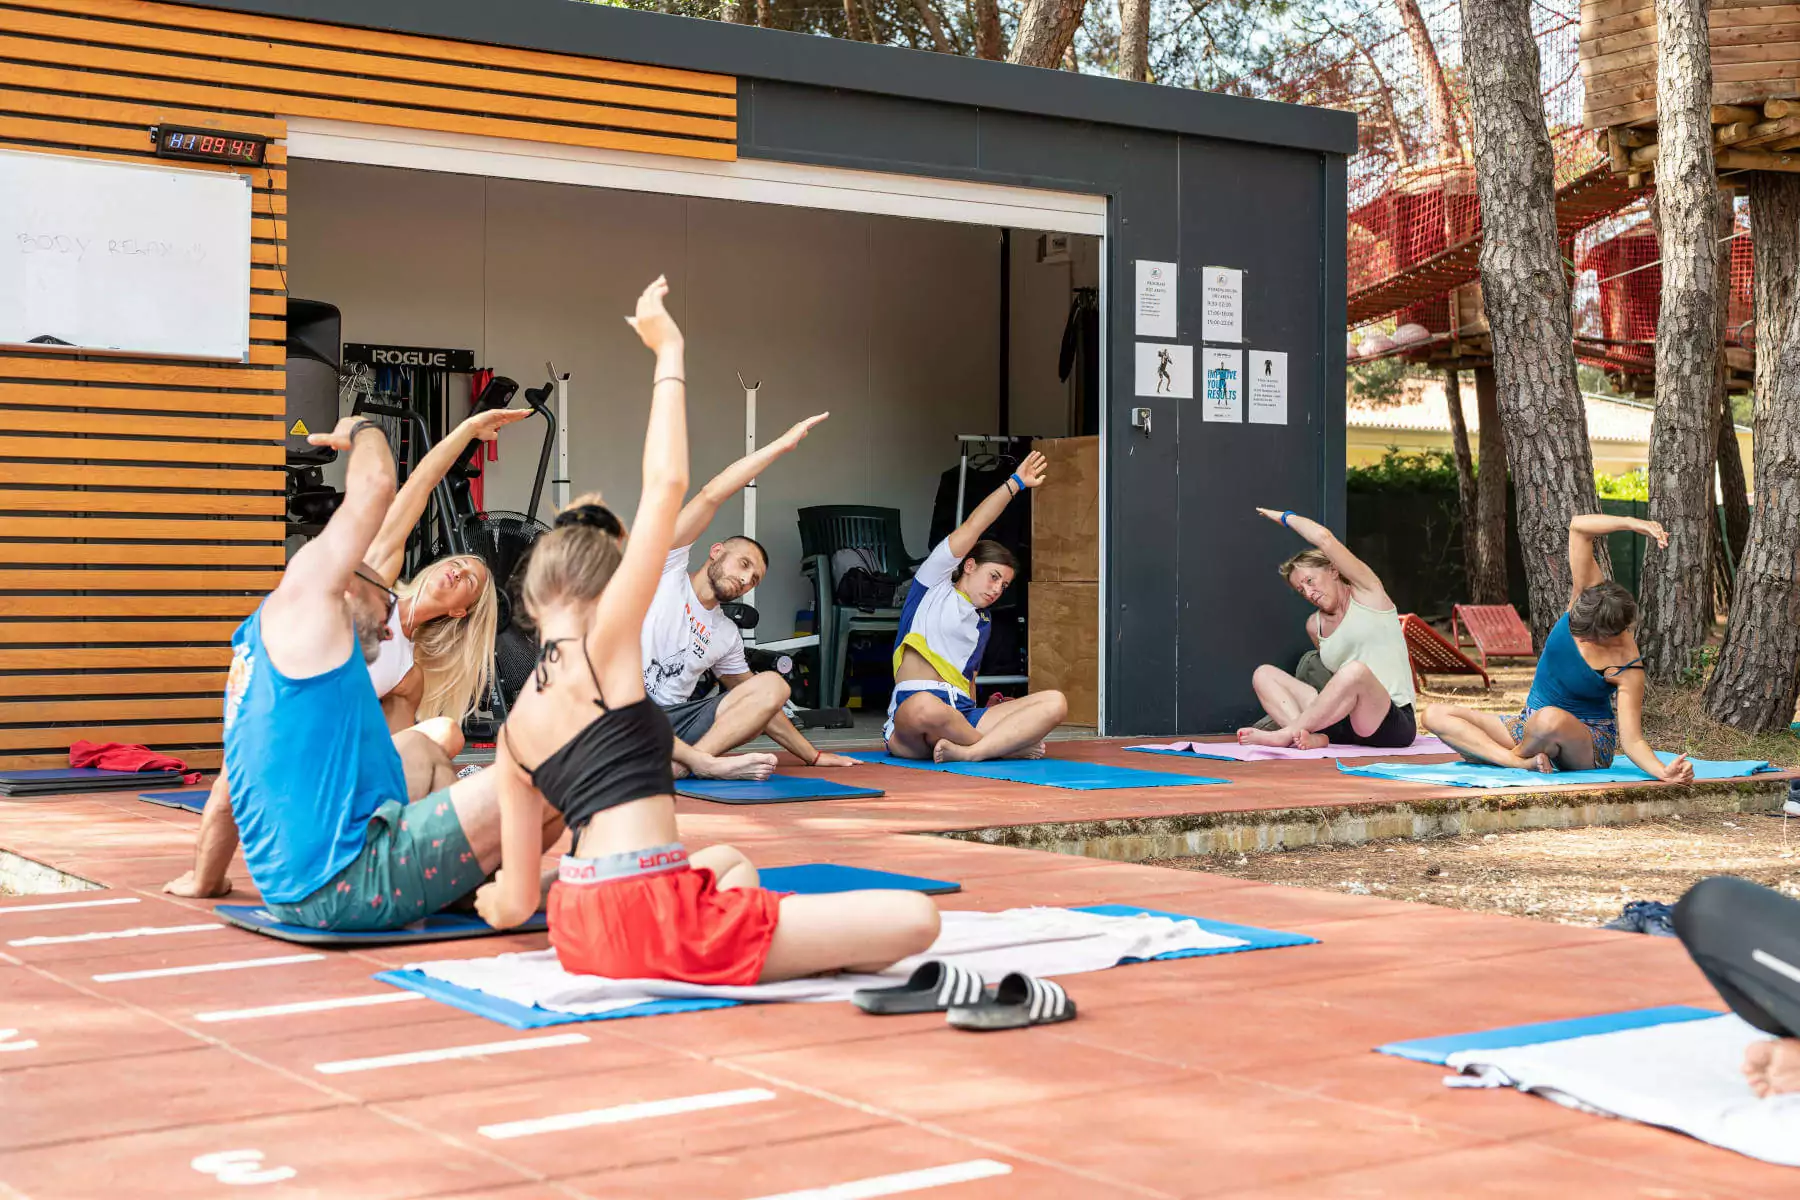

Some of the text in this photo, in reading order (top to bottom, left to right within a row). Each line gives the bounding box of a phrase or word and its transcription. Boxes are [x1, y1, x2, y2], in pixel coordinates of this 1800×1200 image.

[15, 231, 91, 262] BODY
[372, 349, 447, 367] ROGUE
[1208, 390, 1237, 400] RESULTS
